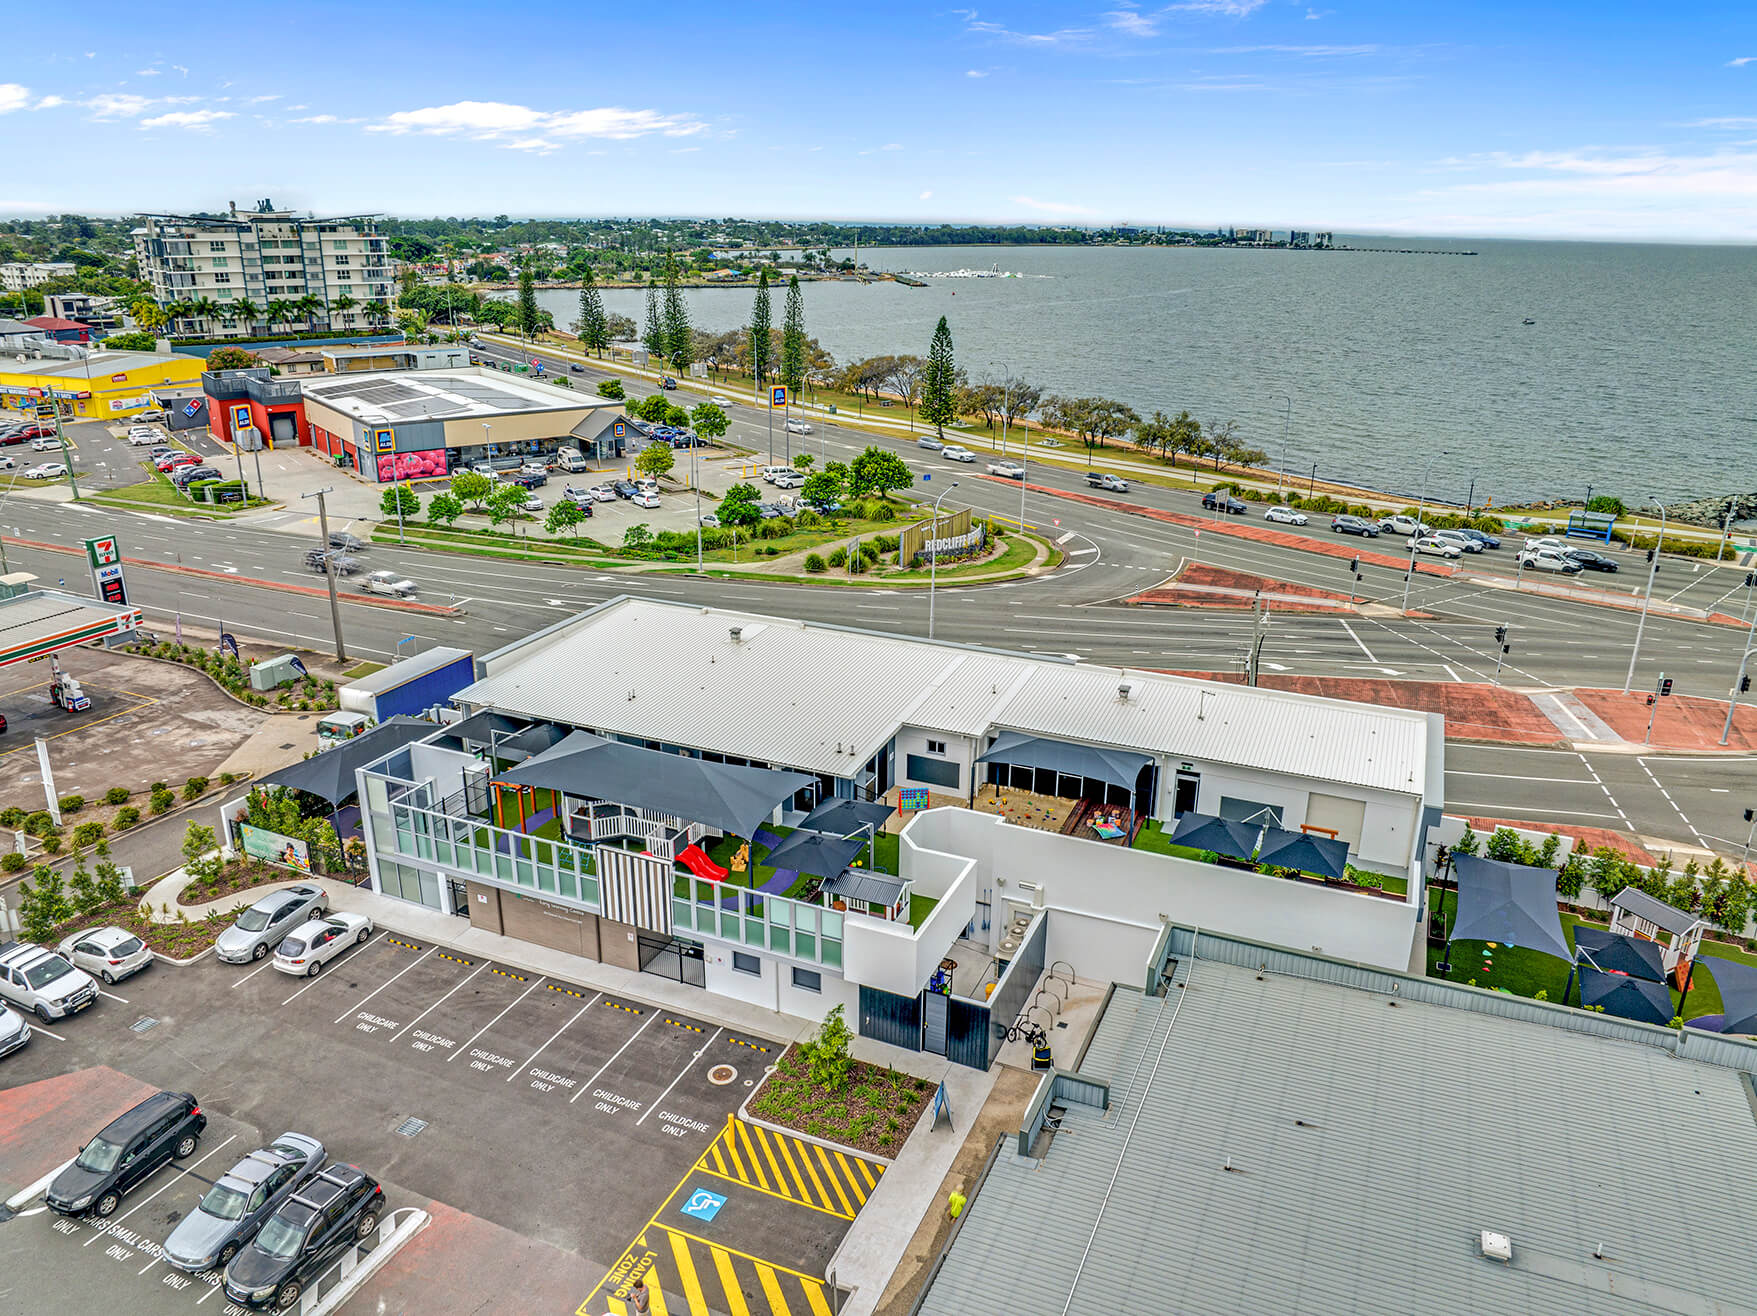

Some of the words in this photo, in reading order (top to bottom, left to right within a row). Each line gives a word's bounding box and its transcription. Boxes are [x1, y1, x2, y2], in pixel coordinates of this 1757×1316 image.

[100, 568, 119, 578] Mobil
[355, 1022, 379, 1034] ONLY
[356, 1011, 400, 1030] CHILDCARE
[411, 1040, 435, 1053] ONLY
[412, 1029, 457, 1049] CHILDCARE
[469, 1048, 516, 1068] CHILDCARE
[469, 1060, 494, 1073] ONLY
[529, 1067, 577, 1089] CHILDCARE
[530, 1079, 555, 1093] ONLY
[592, 1088, 642, 1111] CHILDCARE
[594, 1101, 620, 1115] ONLY
[658, 1111, 710, 1134] CHILDCARE
[661, 1124, 688, 1137] ONLY
[52, 1219, 80, 1236] ONLY
[107, 1225, 142, 1246] SMALL
[136, 1239, 165, 1258] CARS
[105, 1244, 134, 1262] ONLY
[607, 1253, 639, 1285] ZONE
[613, 1250, 658, 1298] LOADING
[162, 1273, 192, 1291] ONLY
